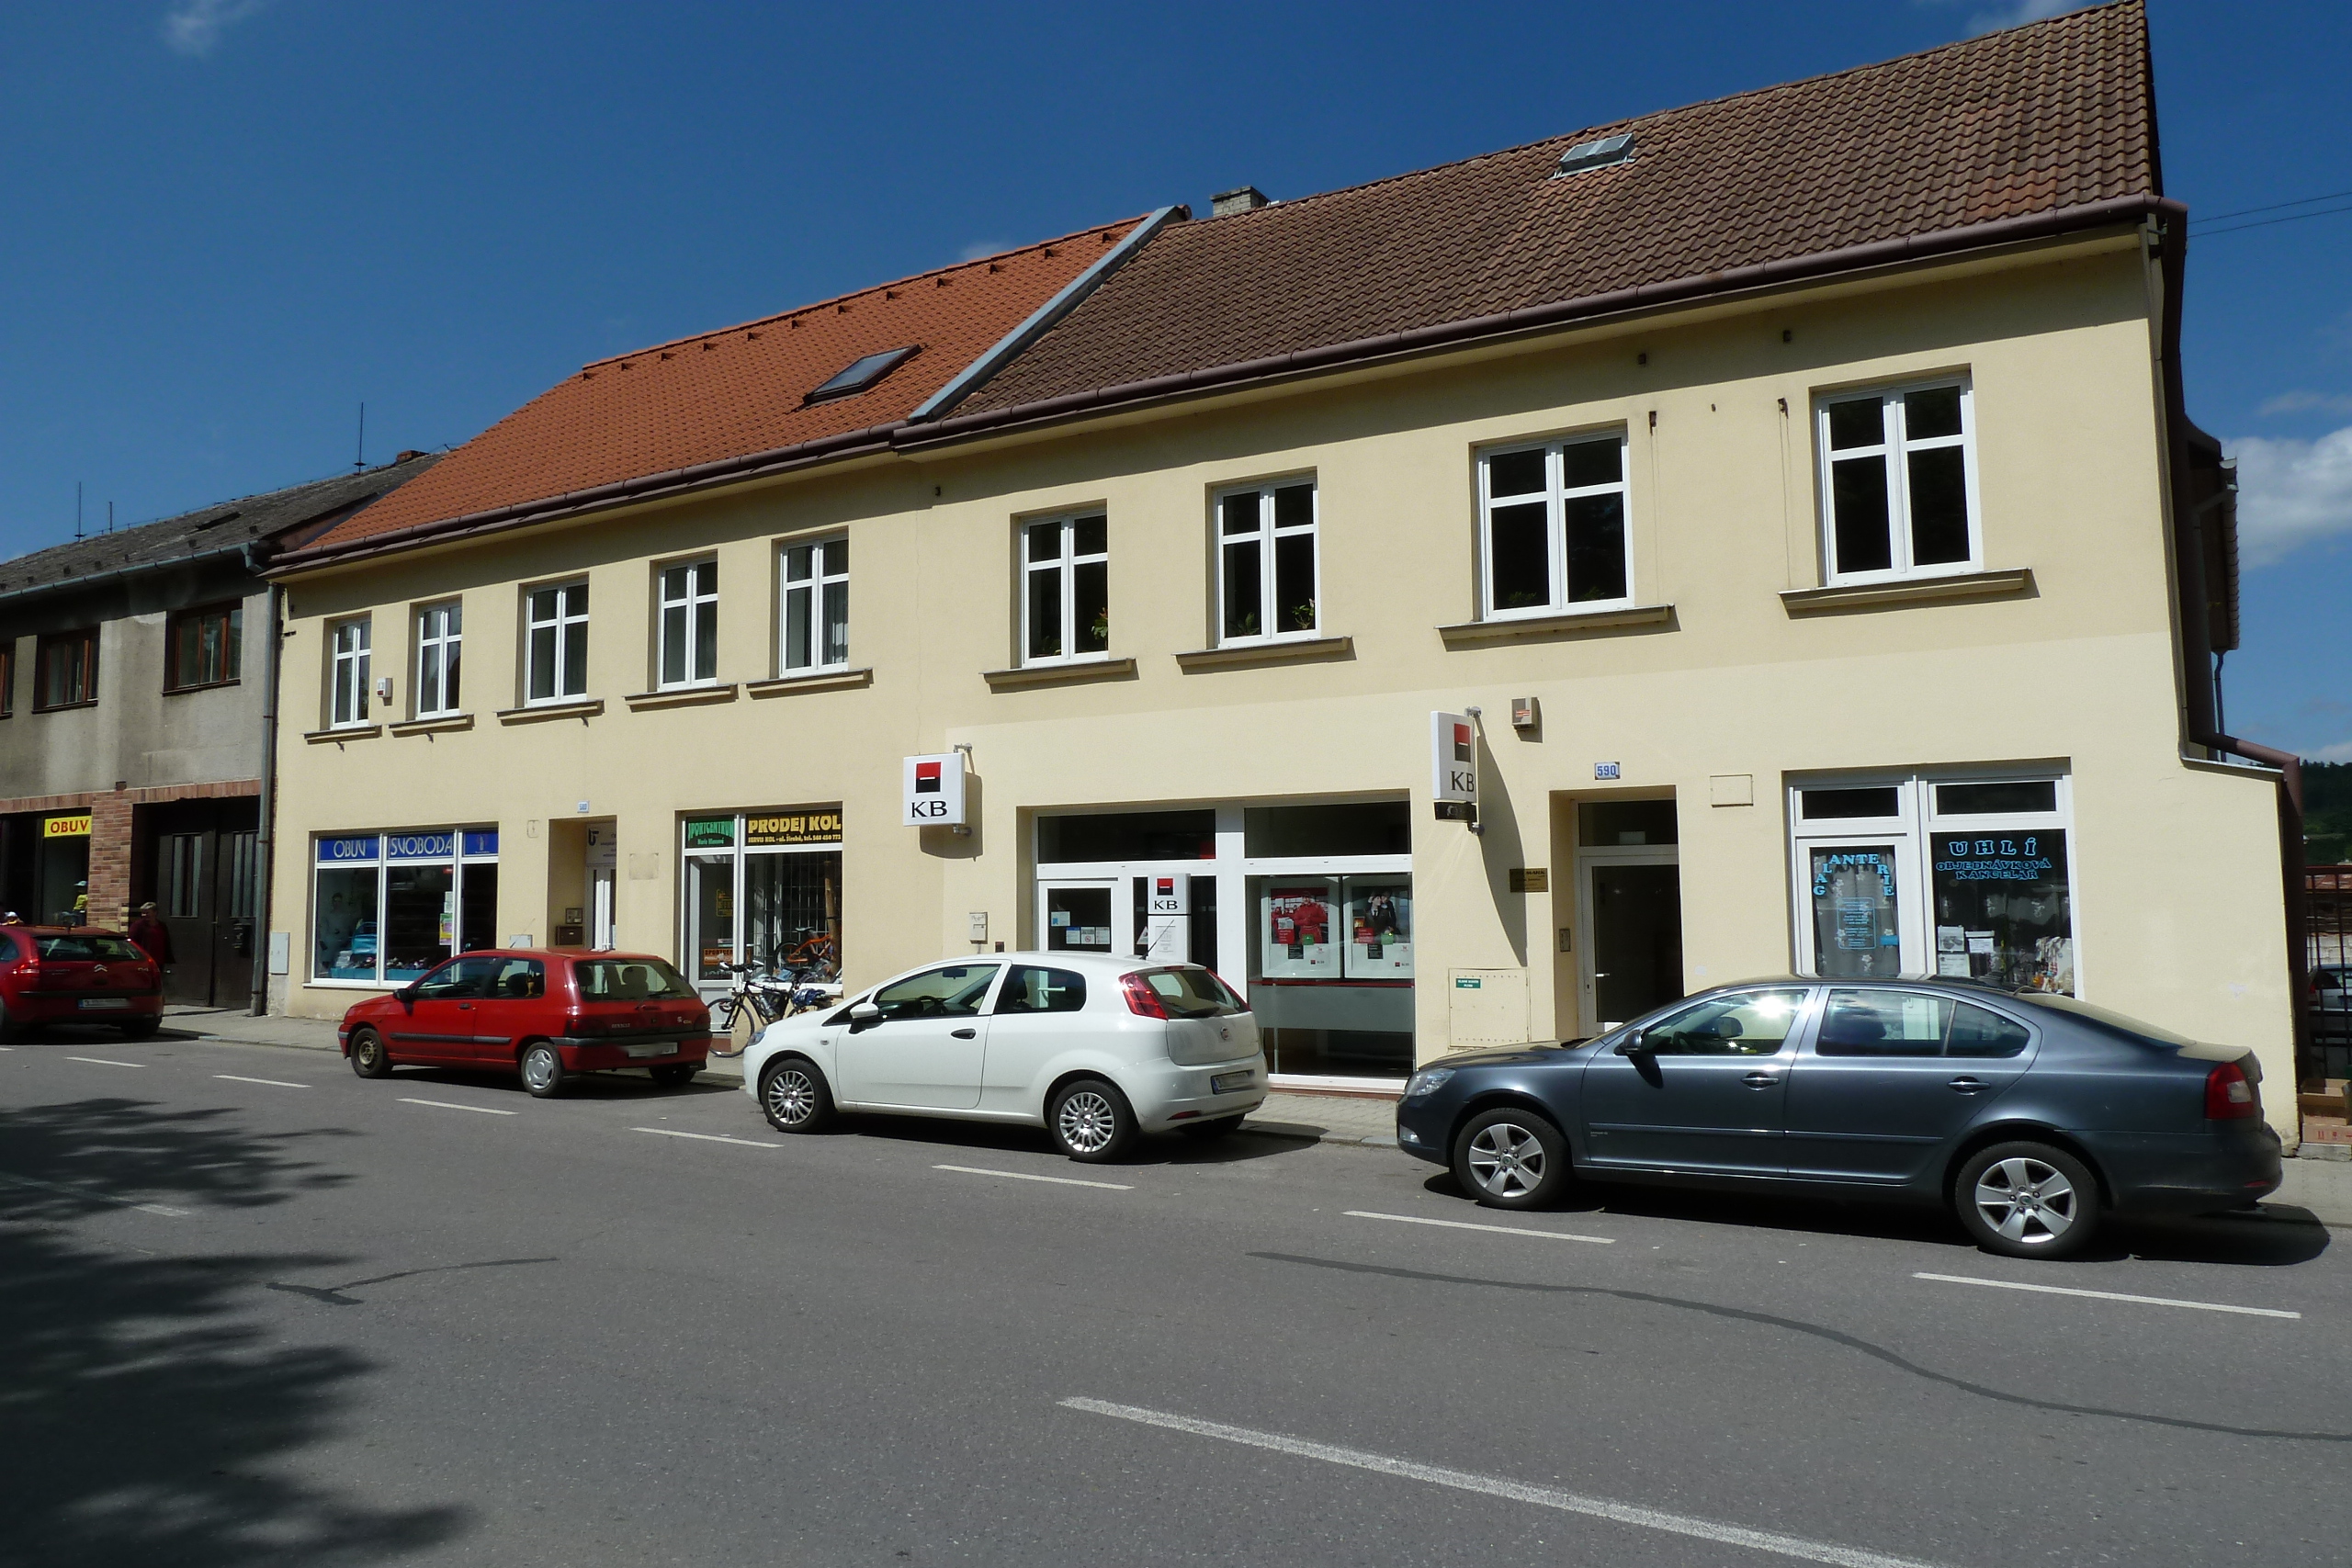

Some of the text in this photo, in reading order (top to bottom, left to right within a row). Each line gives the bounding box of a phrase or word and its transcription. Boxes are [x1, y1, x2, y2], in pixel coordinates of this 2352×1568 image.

[1597, 764, 1617, 776] 590
[1451, 771, 1475, 792] KB
[910, 800, 948, 818] KB
[51, 819, 89, 833] OBUV
[748, 815, 842, 834] PRODEJ KOL
[334, 836, 453, 858] OBUV SVOBODA
[1949, 837, 2036, 856] UHLÍ
[1936, 856, 2052, 872] OBJEDNÁVKOVÁ
[1154, 900, 1178, 910] KB
